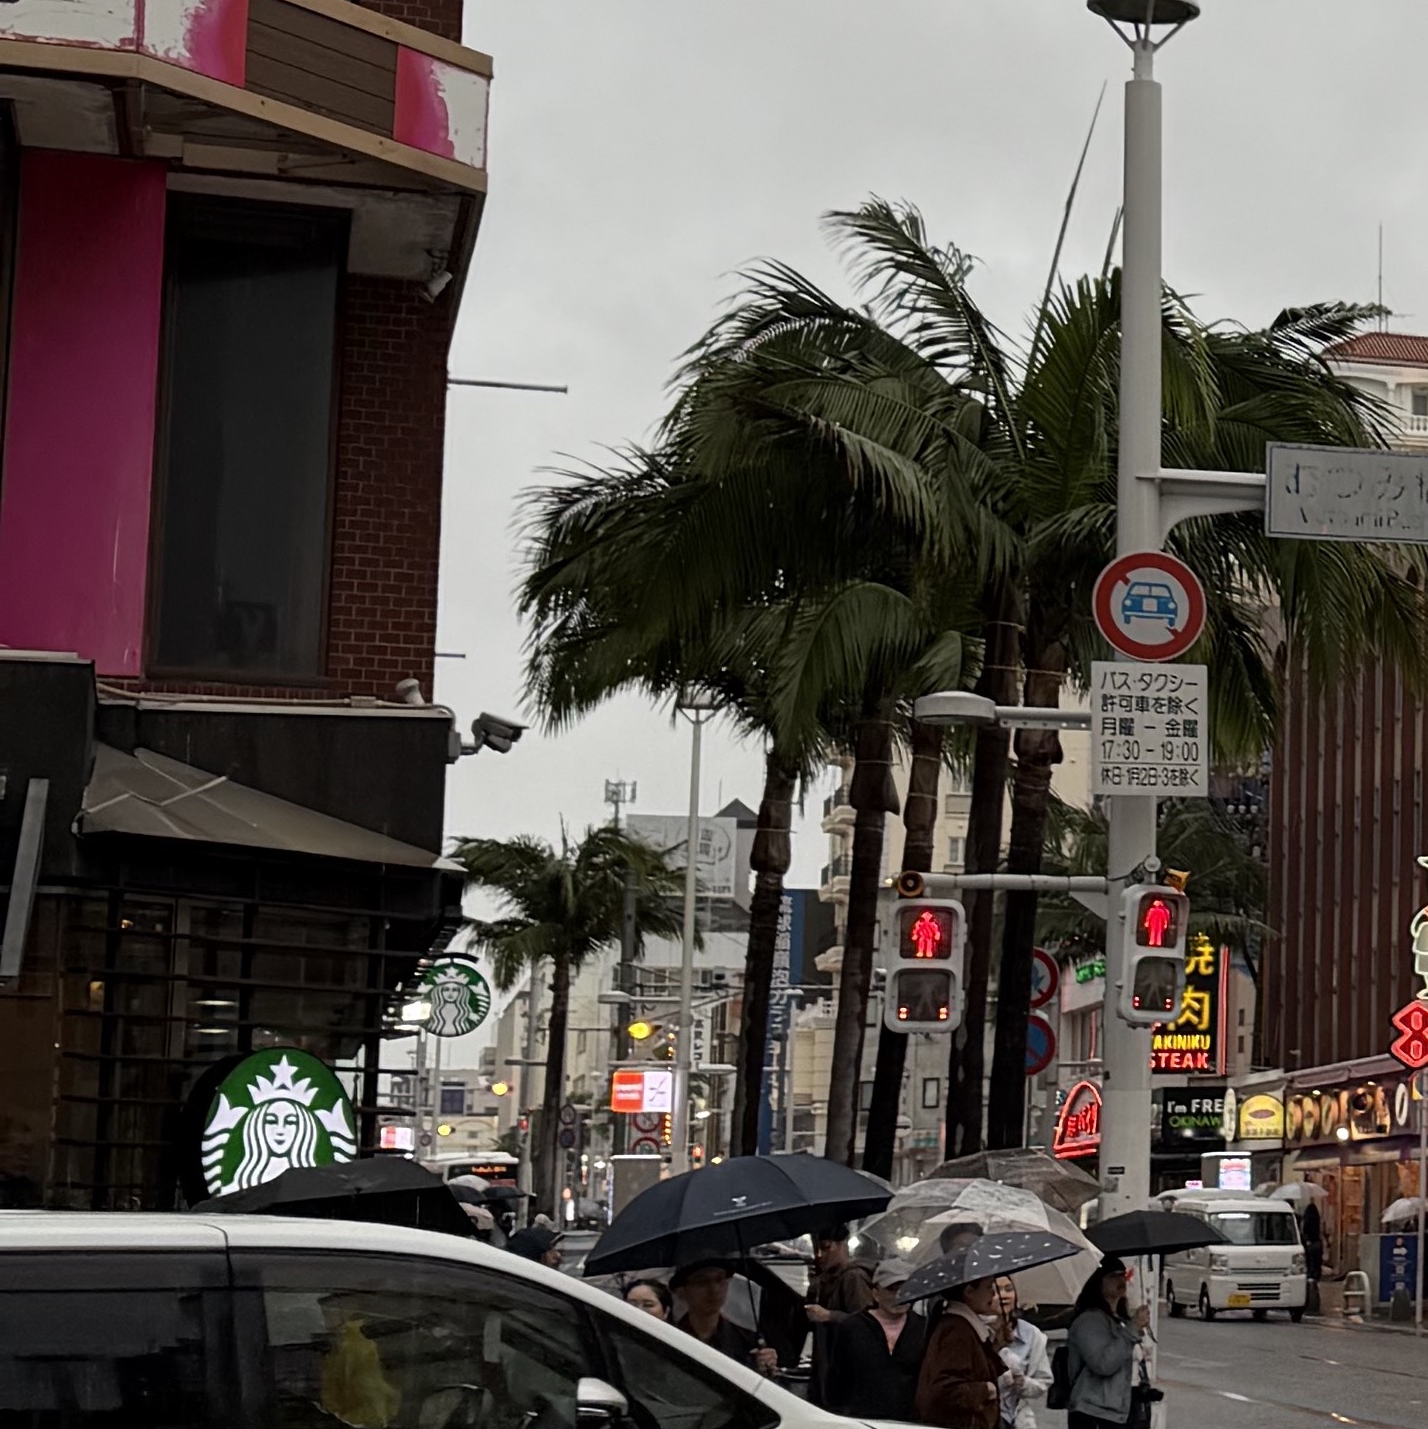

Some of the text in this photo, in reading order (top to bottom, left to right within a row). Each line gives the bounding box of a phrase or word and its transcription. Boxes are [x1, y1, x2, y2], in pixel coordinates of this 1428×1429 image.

[1101, 693, 1198, 715] 許可車を除く
[1101, 739, 1140, 760] 17:30
[1160, 740, 1199, 762] 19:00
[1151, 1035, 1211, 1050] AKINIKU
[1191, 1098, 1223, 1113] FRE
[1169, 1115, 1222, 1128] OKINAW
